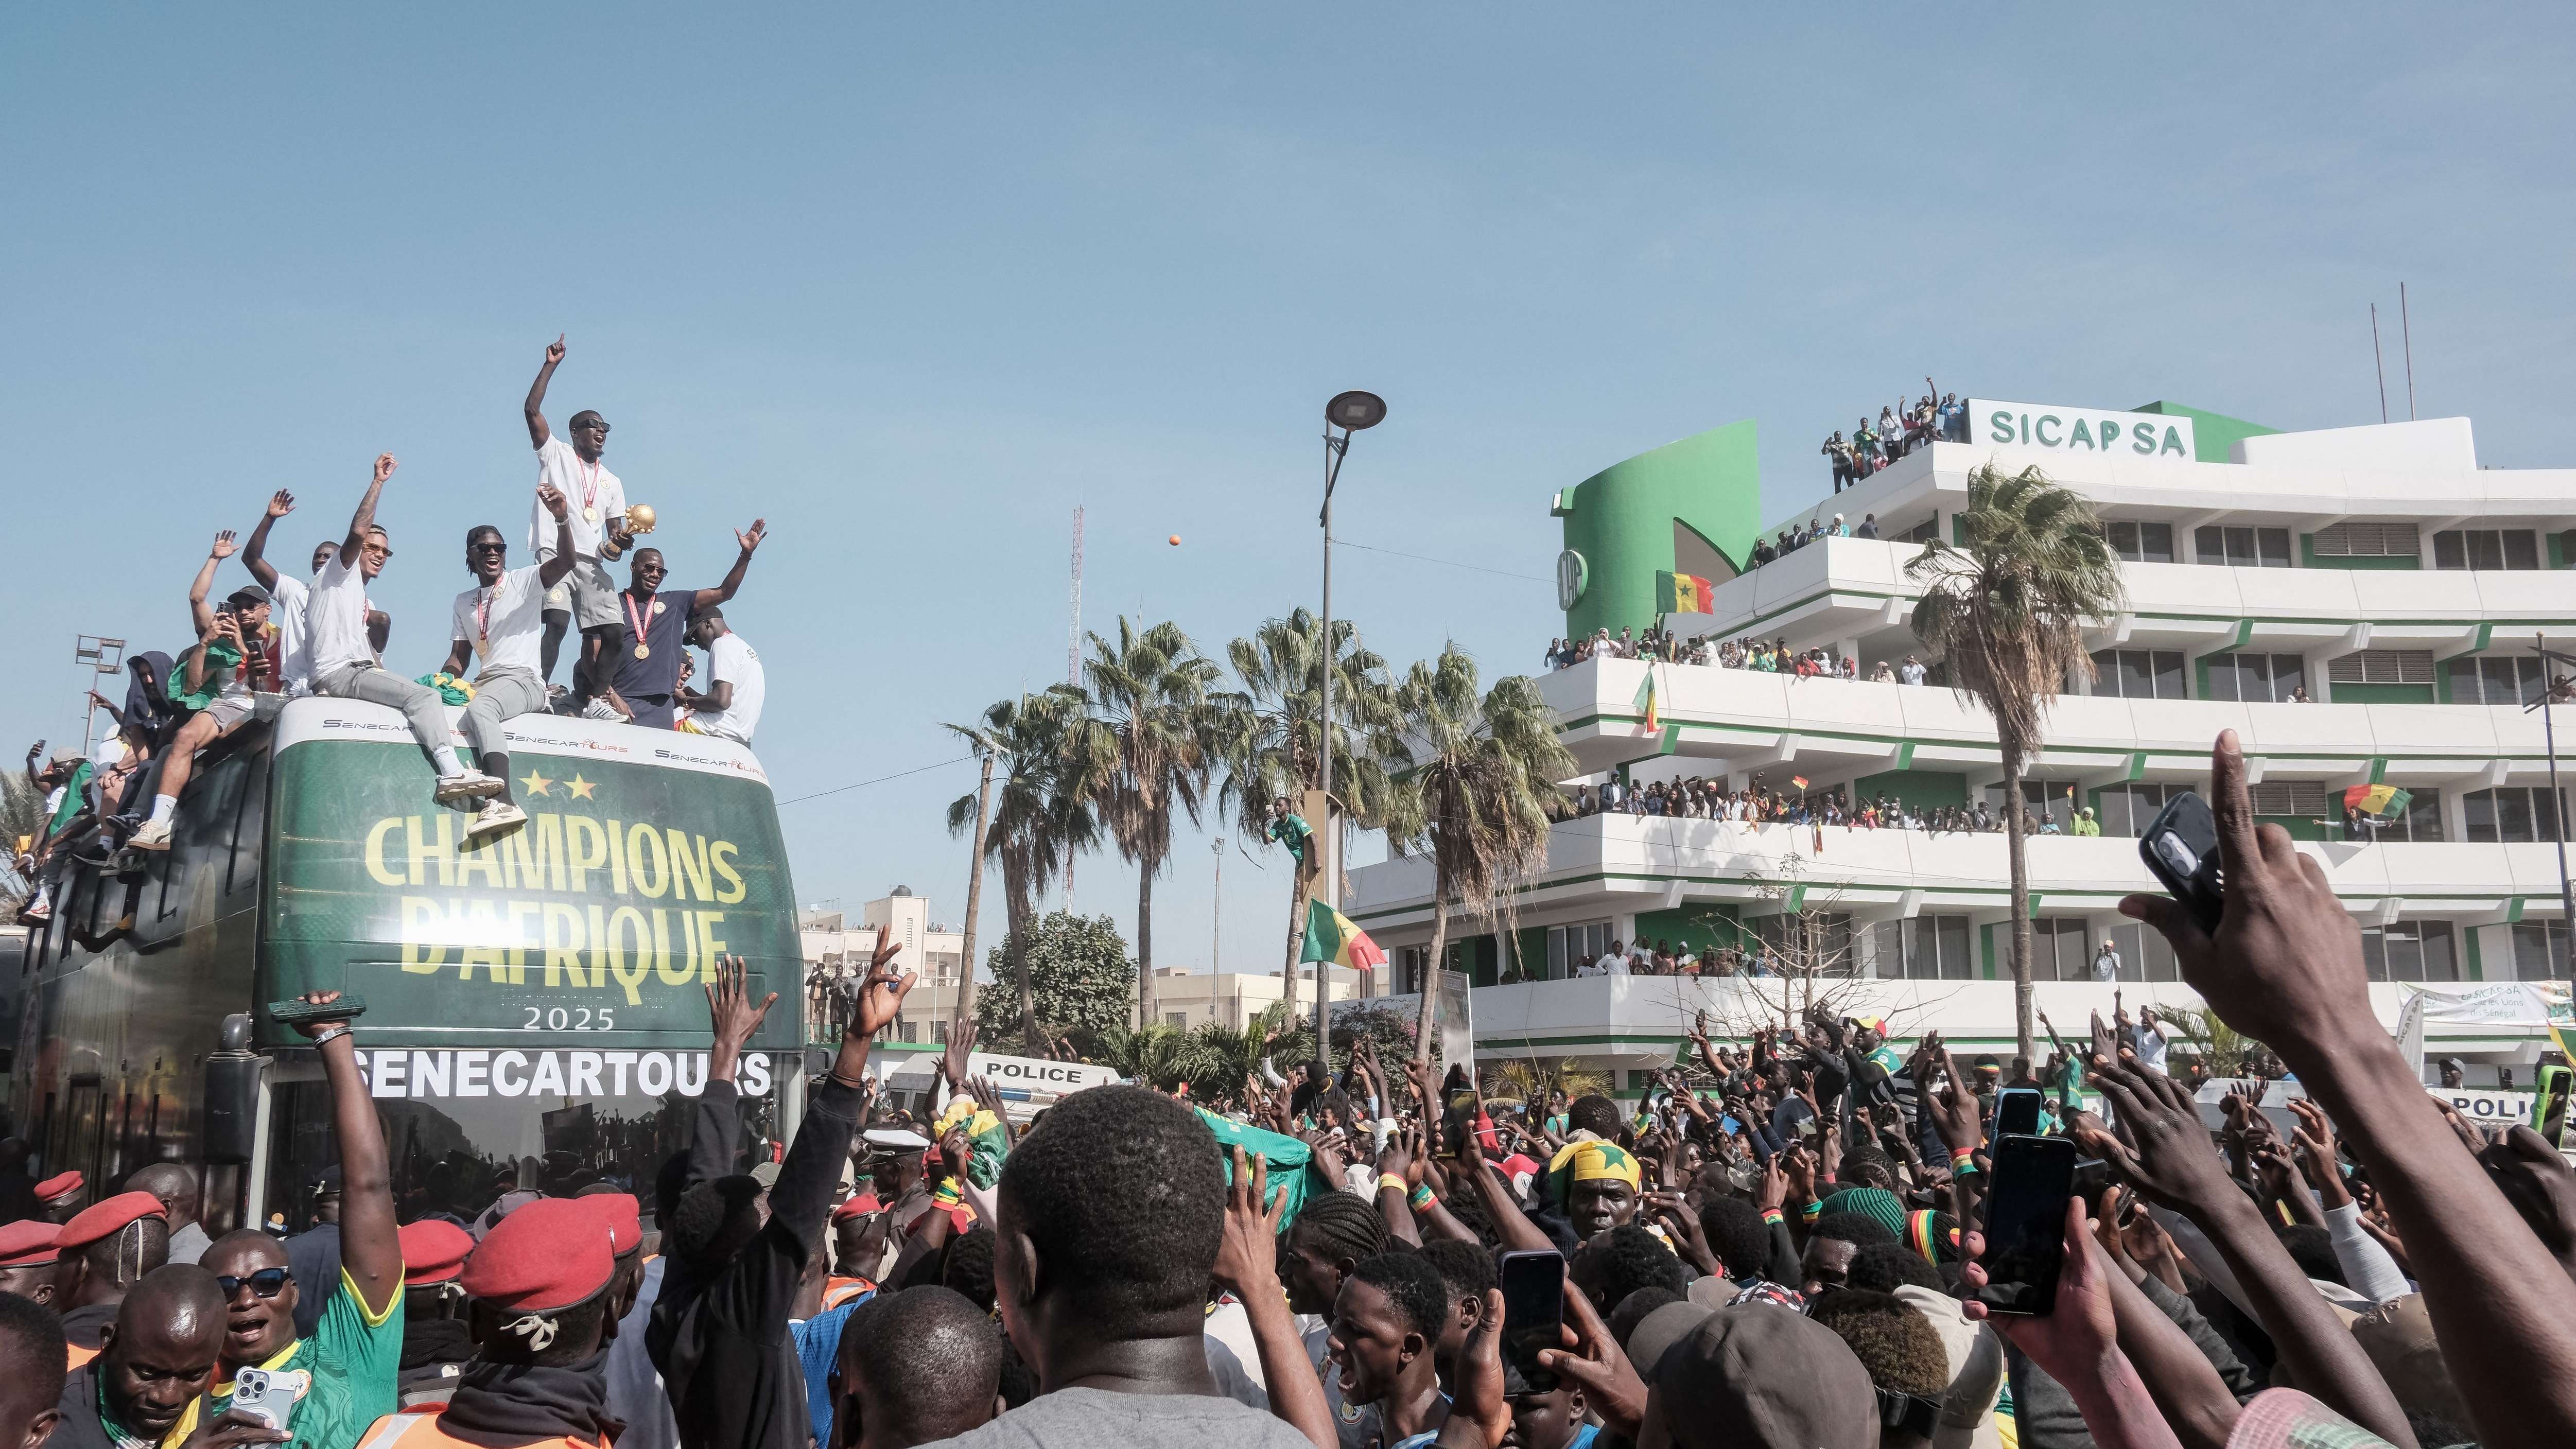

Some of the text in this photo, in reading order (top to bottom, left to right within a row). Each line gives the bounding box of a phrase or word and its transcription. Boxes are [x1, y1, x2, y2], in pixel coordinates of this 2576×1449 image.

[1991, 411, 2186, 457] SICAP SA
[322, 719, 467, 736] SENECARRS
[365, 812, 746, 904] CHAMPIONS
[401, 896, 727, 1006] D'AFRIQUE
[2483, 1008, 2516, 1018] Sénégal
[2501, 998, 2524, 1006] Lions
[524, 1006, 614, 1031] 2025
[354, 1050, 771, 1097] ENECARTOUS
[986, 1062, 1082, 1084] POLICE
